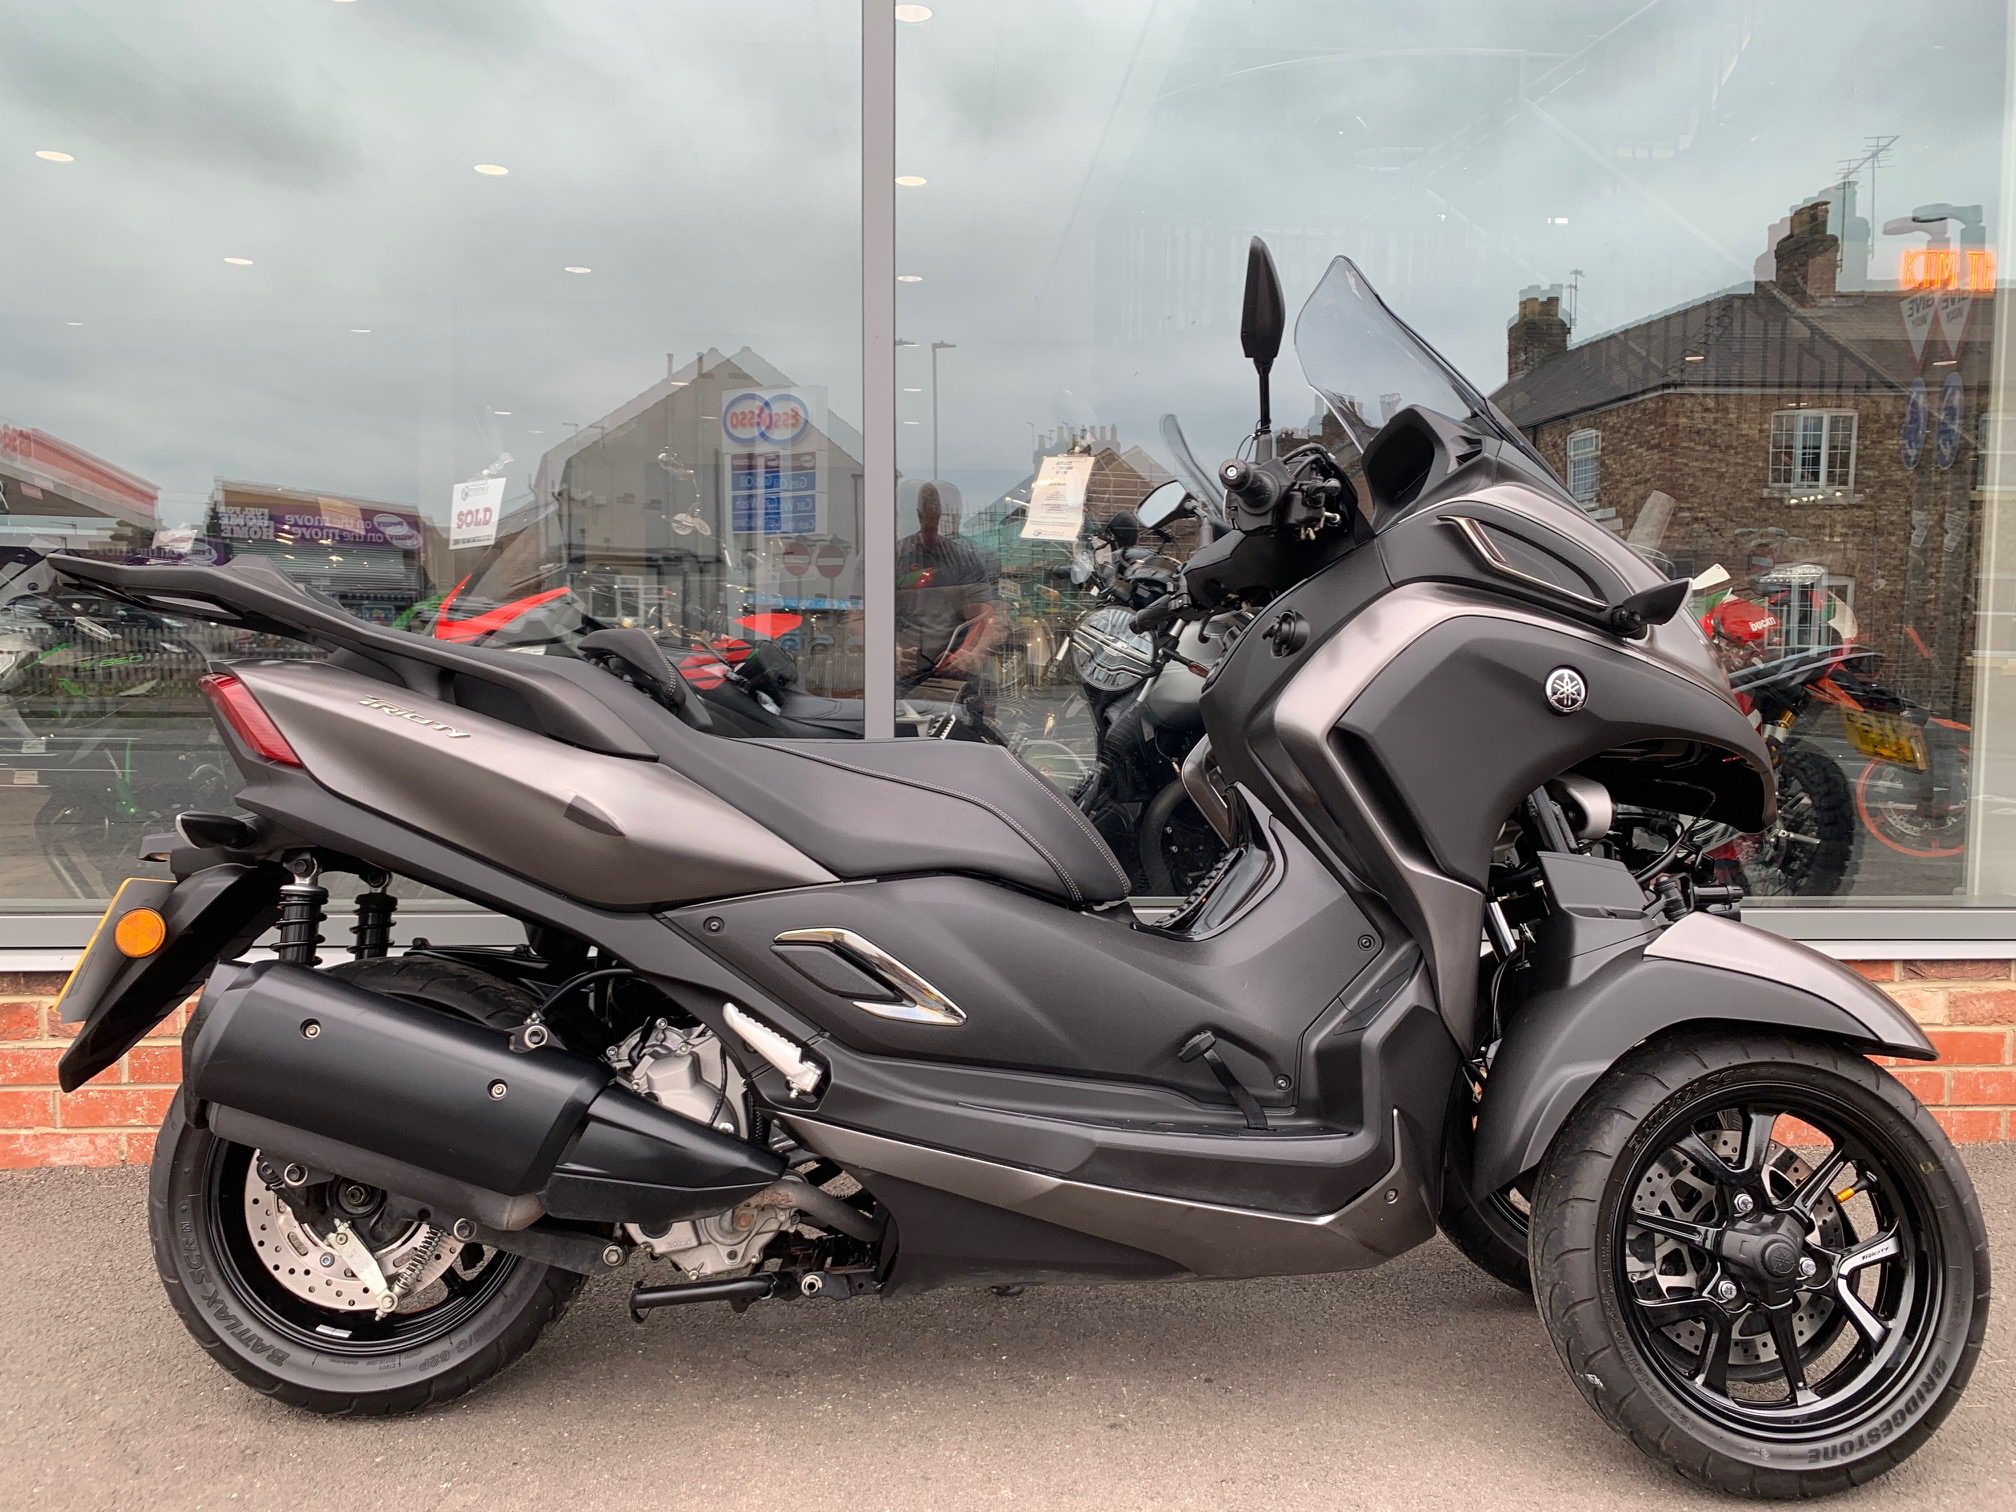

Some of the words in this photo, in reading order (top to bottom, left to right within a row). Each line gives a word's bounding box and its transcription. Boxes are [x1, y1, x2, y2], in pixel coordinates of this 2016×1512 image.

[1902, 249, 1958, 290] KTM
[456, 507, 493, 529] SOLD
[1749, 616, 1776, 632] DUCATI
[359, 694, 471, 738] TRICITY
[201, 1288, 292, 1368] BATTLAX
[1807, 1354, 1948, 1464] BRIDGESTONE
